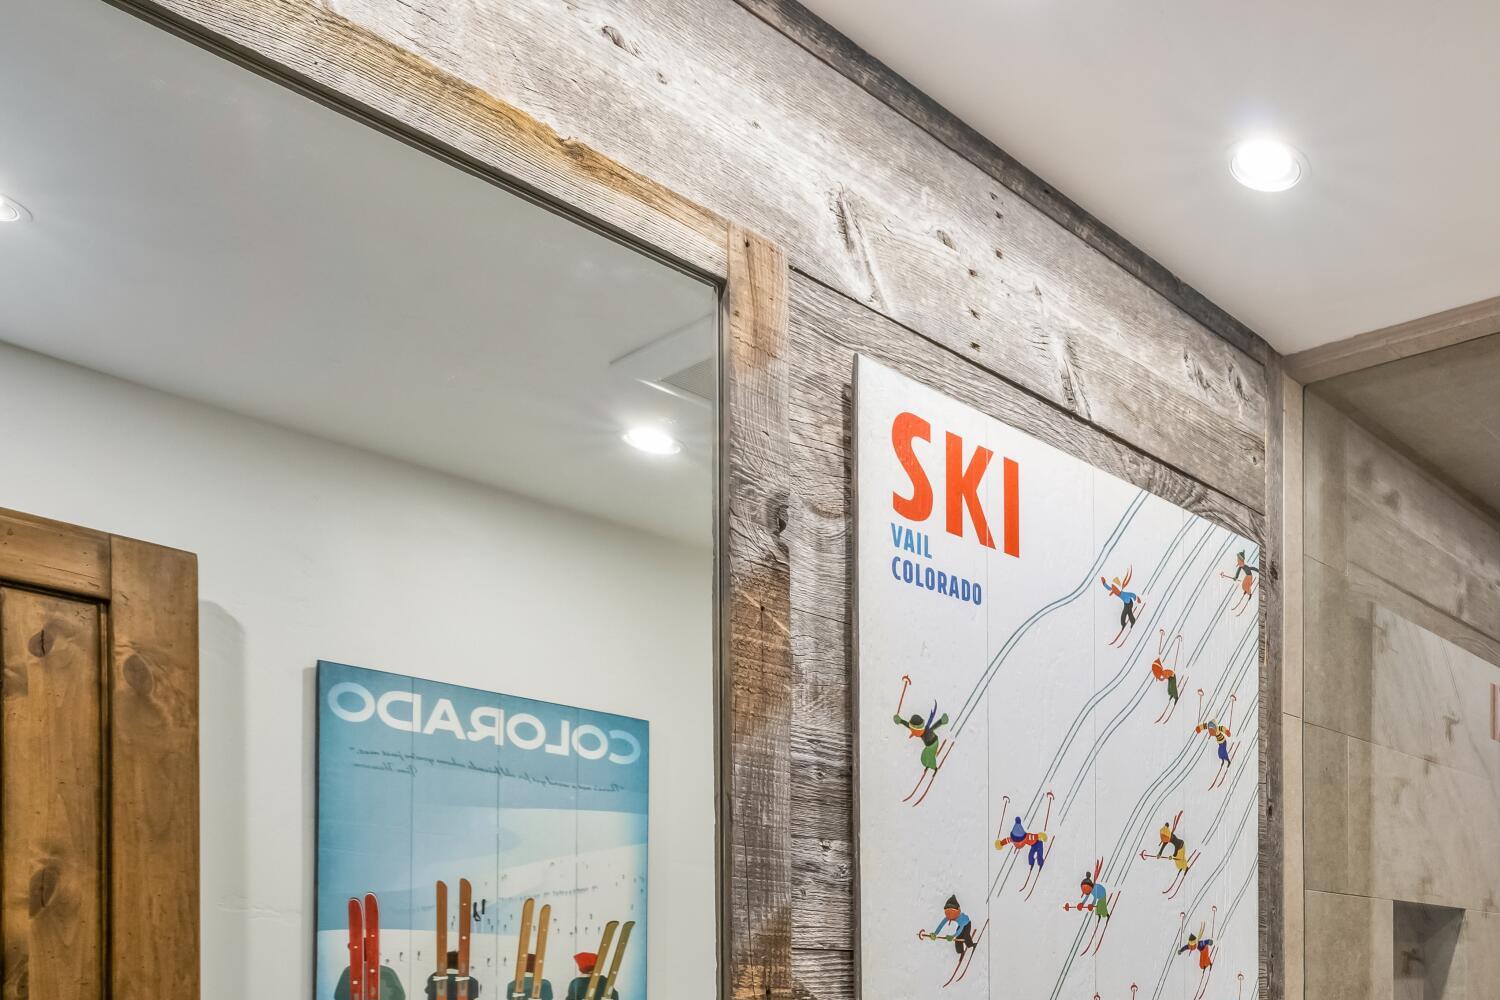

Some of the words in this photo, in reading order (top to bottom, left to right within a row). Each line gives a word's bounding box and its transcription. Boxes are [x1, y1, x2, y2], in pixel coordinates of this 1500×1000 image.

[891, 411, 1020, 558] SKI
[890, 522, 933, 559] VAIL
[891, 556, 982, 605] COLORADO
